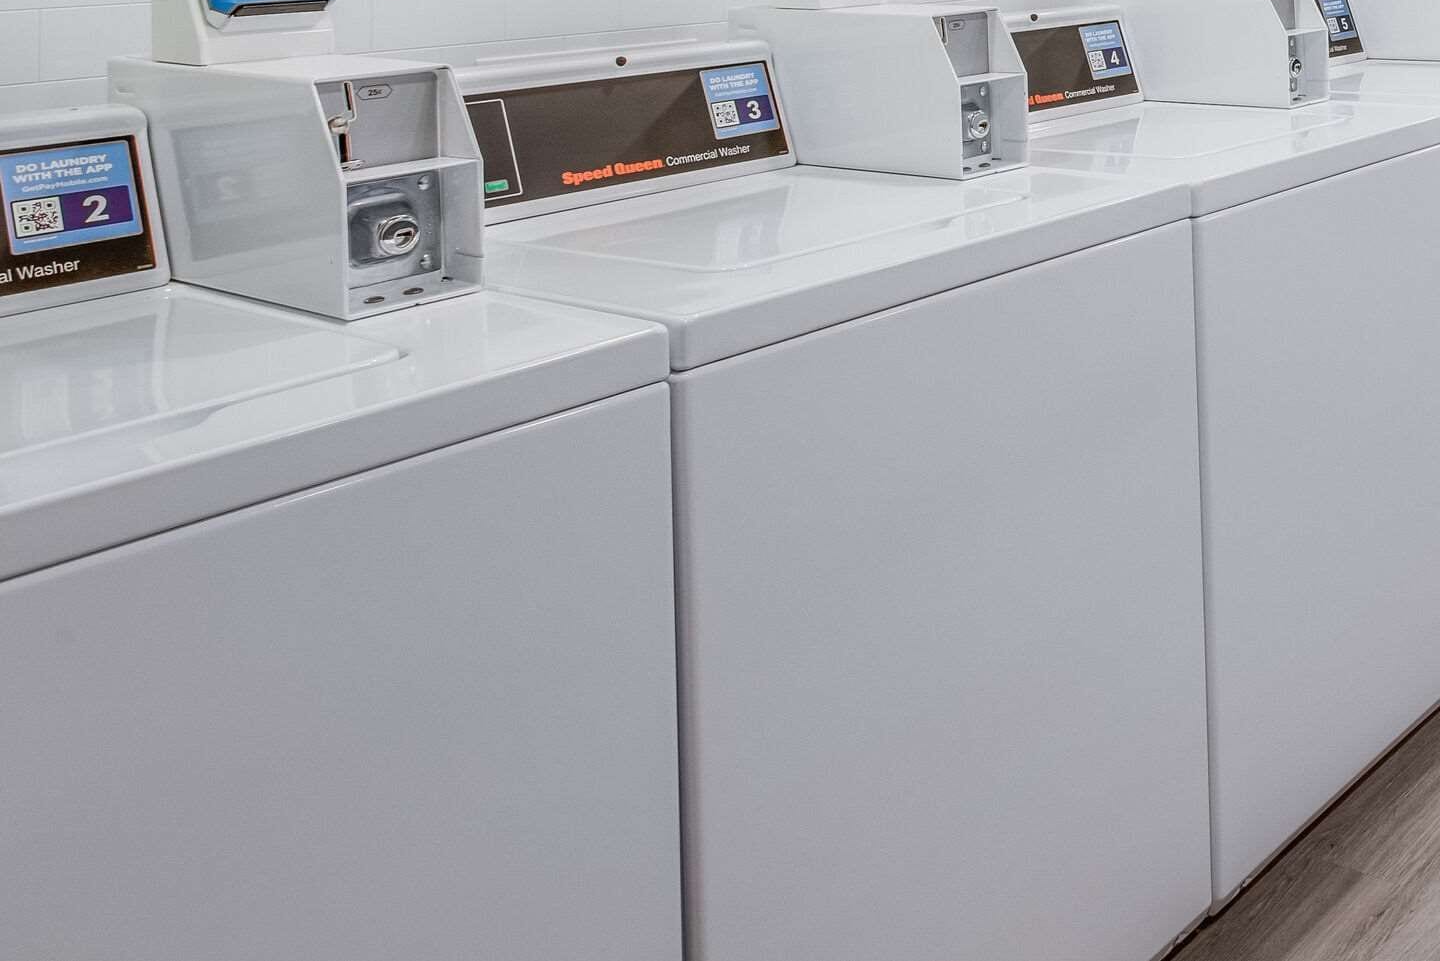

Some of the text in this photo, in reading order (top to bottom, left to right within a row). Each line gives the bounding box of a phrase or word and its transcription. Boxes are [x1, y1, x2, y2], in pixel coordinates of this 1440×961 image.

[1341, 18, 1348, 30] 5
[1110, 51, 1120, 65] 4
[1064, 88, 1096, 98] Commercial
[1096, 84, 1115, 93] Washer
[747, 100, 761, 119] 3
[12, 163, 113, 184] WITH THE APP
[15, 154, 107, 174] DO LAUNDRY
[562, 144, 750, 186] Speed Queen Commercial Washer
[82, 195, 110, 223] 2
[16, 260, 80, 280] Washer
